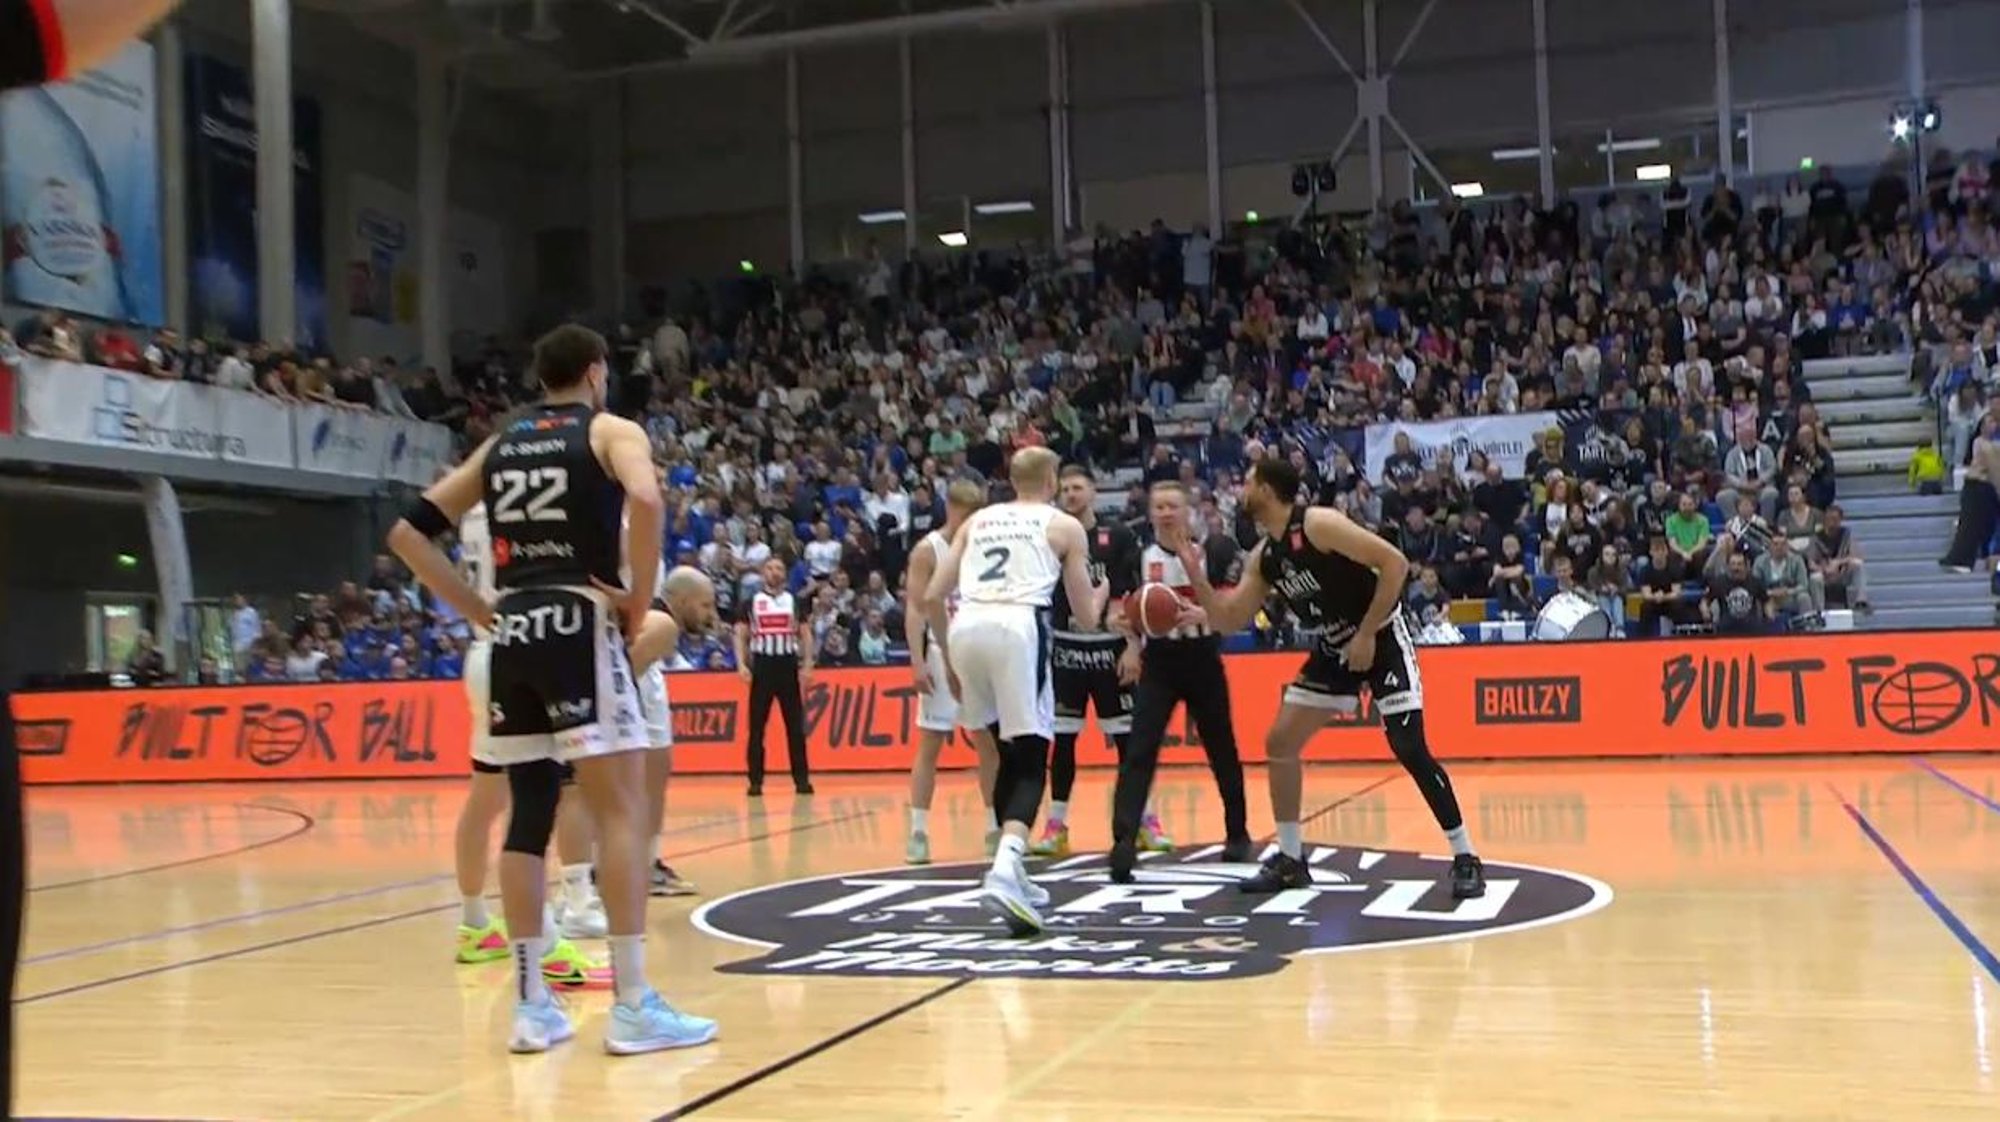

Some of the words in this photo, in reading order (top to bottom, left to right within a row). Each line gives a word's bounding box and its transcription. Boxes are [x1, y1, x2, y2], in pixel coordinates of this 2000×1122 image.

[491, 466, 569, 523] 22
[978, 547, 1010, 582] 2
[1384, 671, 1400, 688] 4
[1662, 652, 1826, 731] BUILT
[1848, 655, 2000, 735] FOR
[1483, 684, 1571, 716] BALLZY
[236, 702, 336, 765] FOR
[359, 698, 438, 762] BALL
[671, 707, 728, 737] ALLZY
[1159, 936, 1258, 952] &
